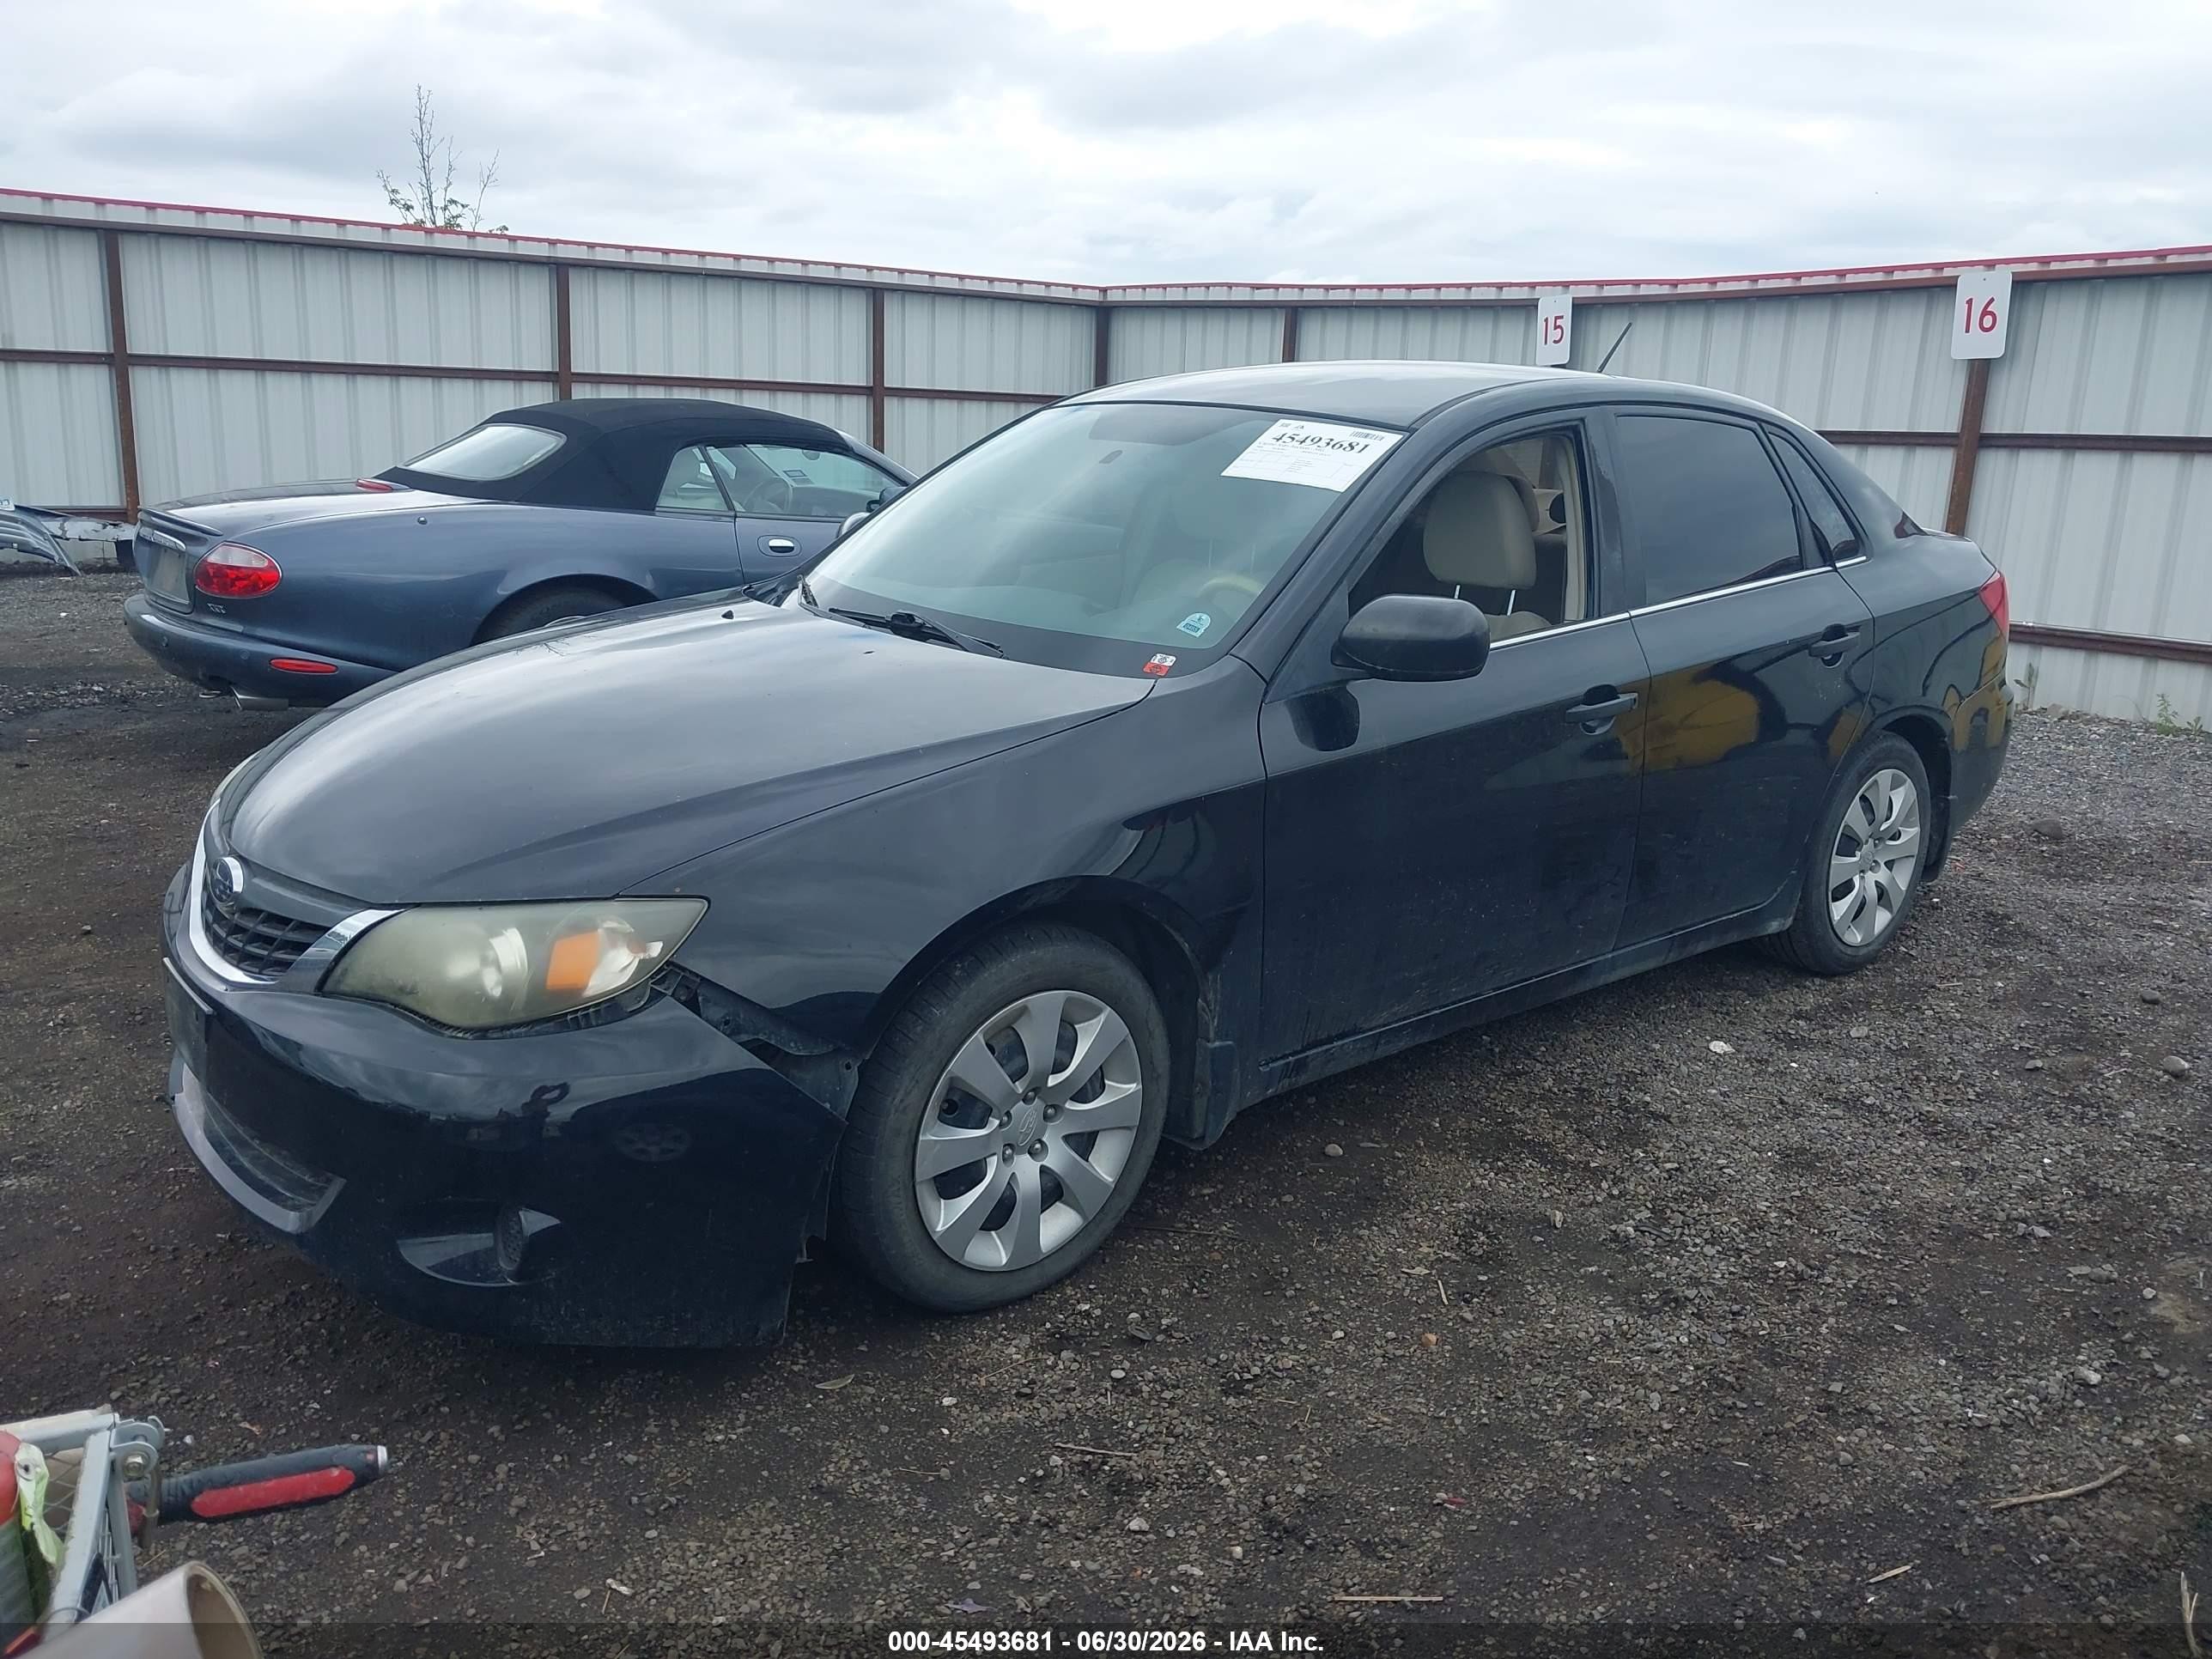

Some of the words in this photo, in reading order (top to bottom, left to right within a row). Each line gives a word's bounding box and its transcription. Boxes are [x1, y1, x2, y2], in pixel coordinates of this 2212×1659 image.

[1543, 314, 1564, 345] 15
[1964, 296, 1998, 334] 16
[1272, 432, 1370, 453] 45493681
